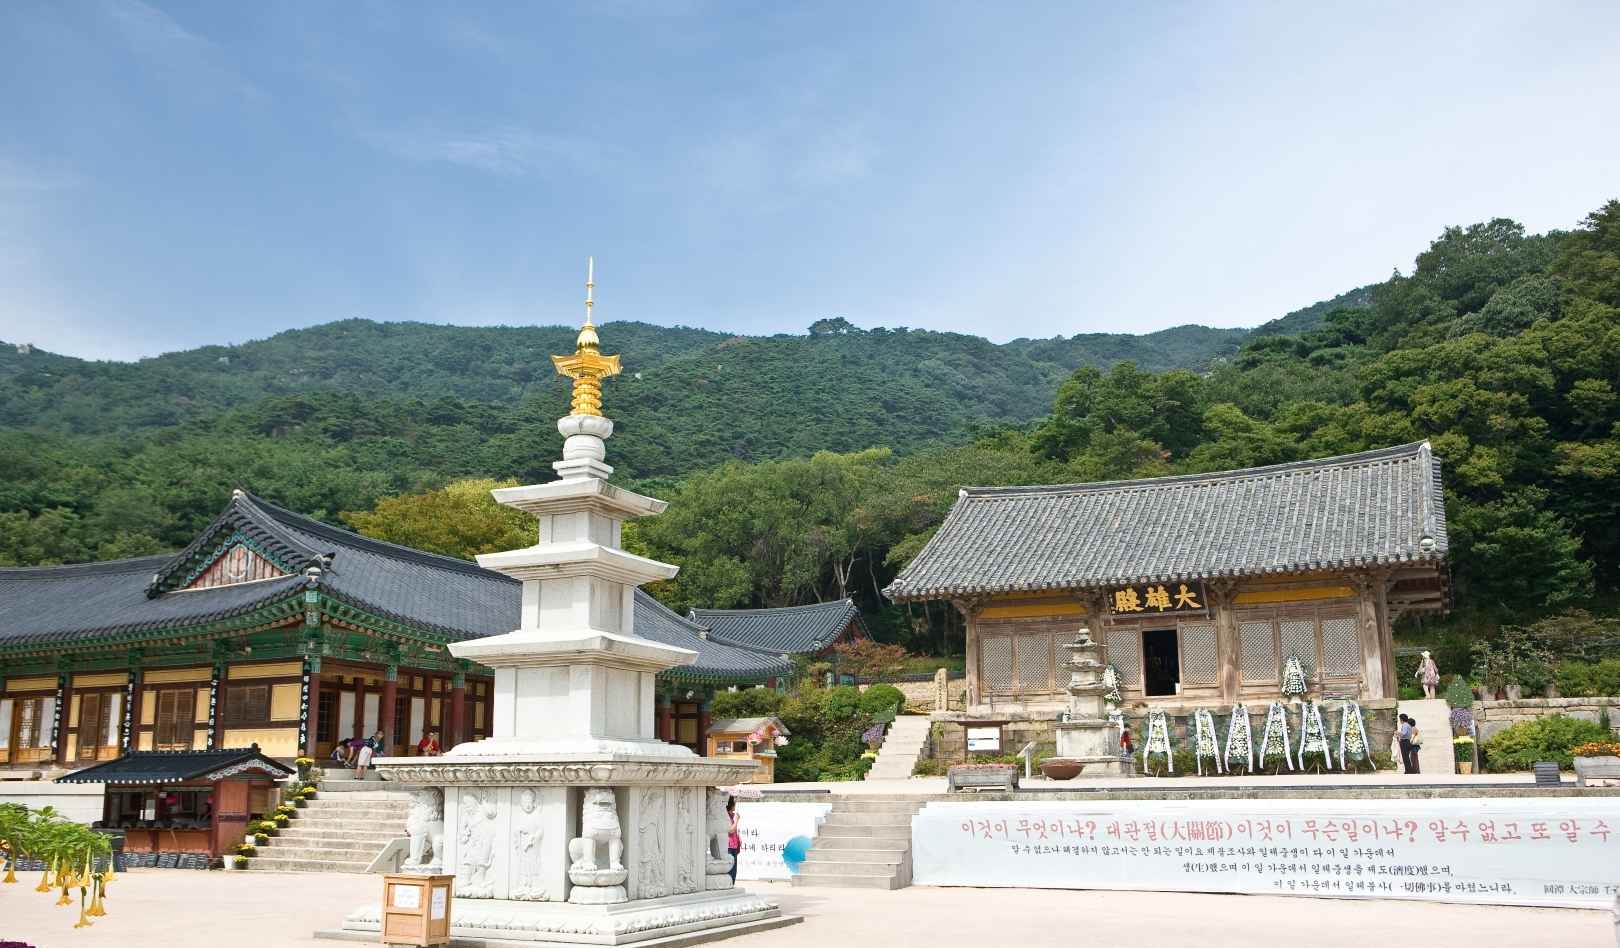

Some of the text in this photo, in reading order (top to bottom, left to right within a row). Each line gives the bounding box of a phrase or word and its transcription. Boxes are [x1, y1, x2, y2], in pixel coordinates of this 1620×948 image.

[961, 820, 1009, 839] 이것이
[1015, 820, 1097, 841] 무엇이냐?
[1479, 820, 1522, 842] 없고
[1530, 822, 1551, 840] 또
[1559, 819, 1581, 842] 알
[1589, 819, 1612, 841] 수
